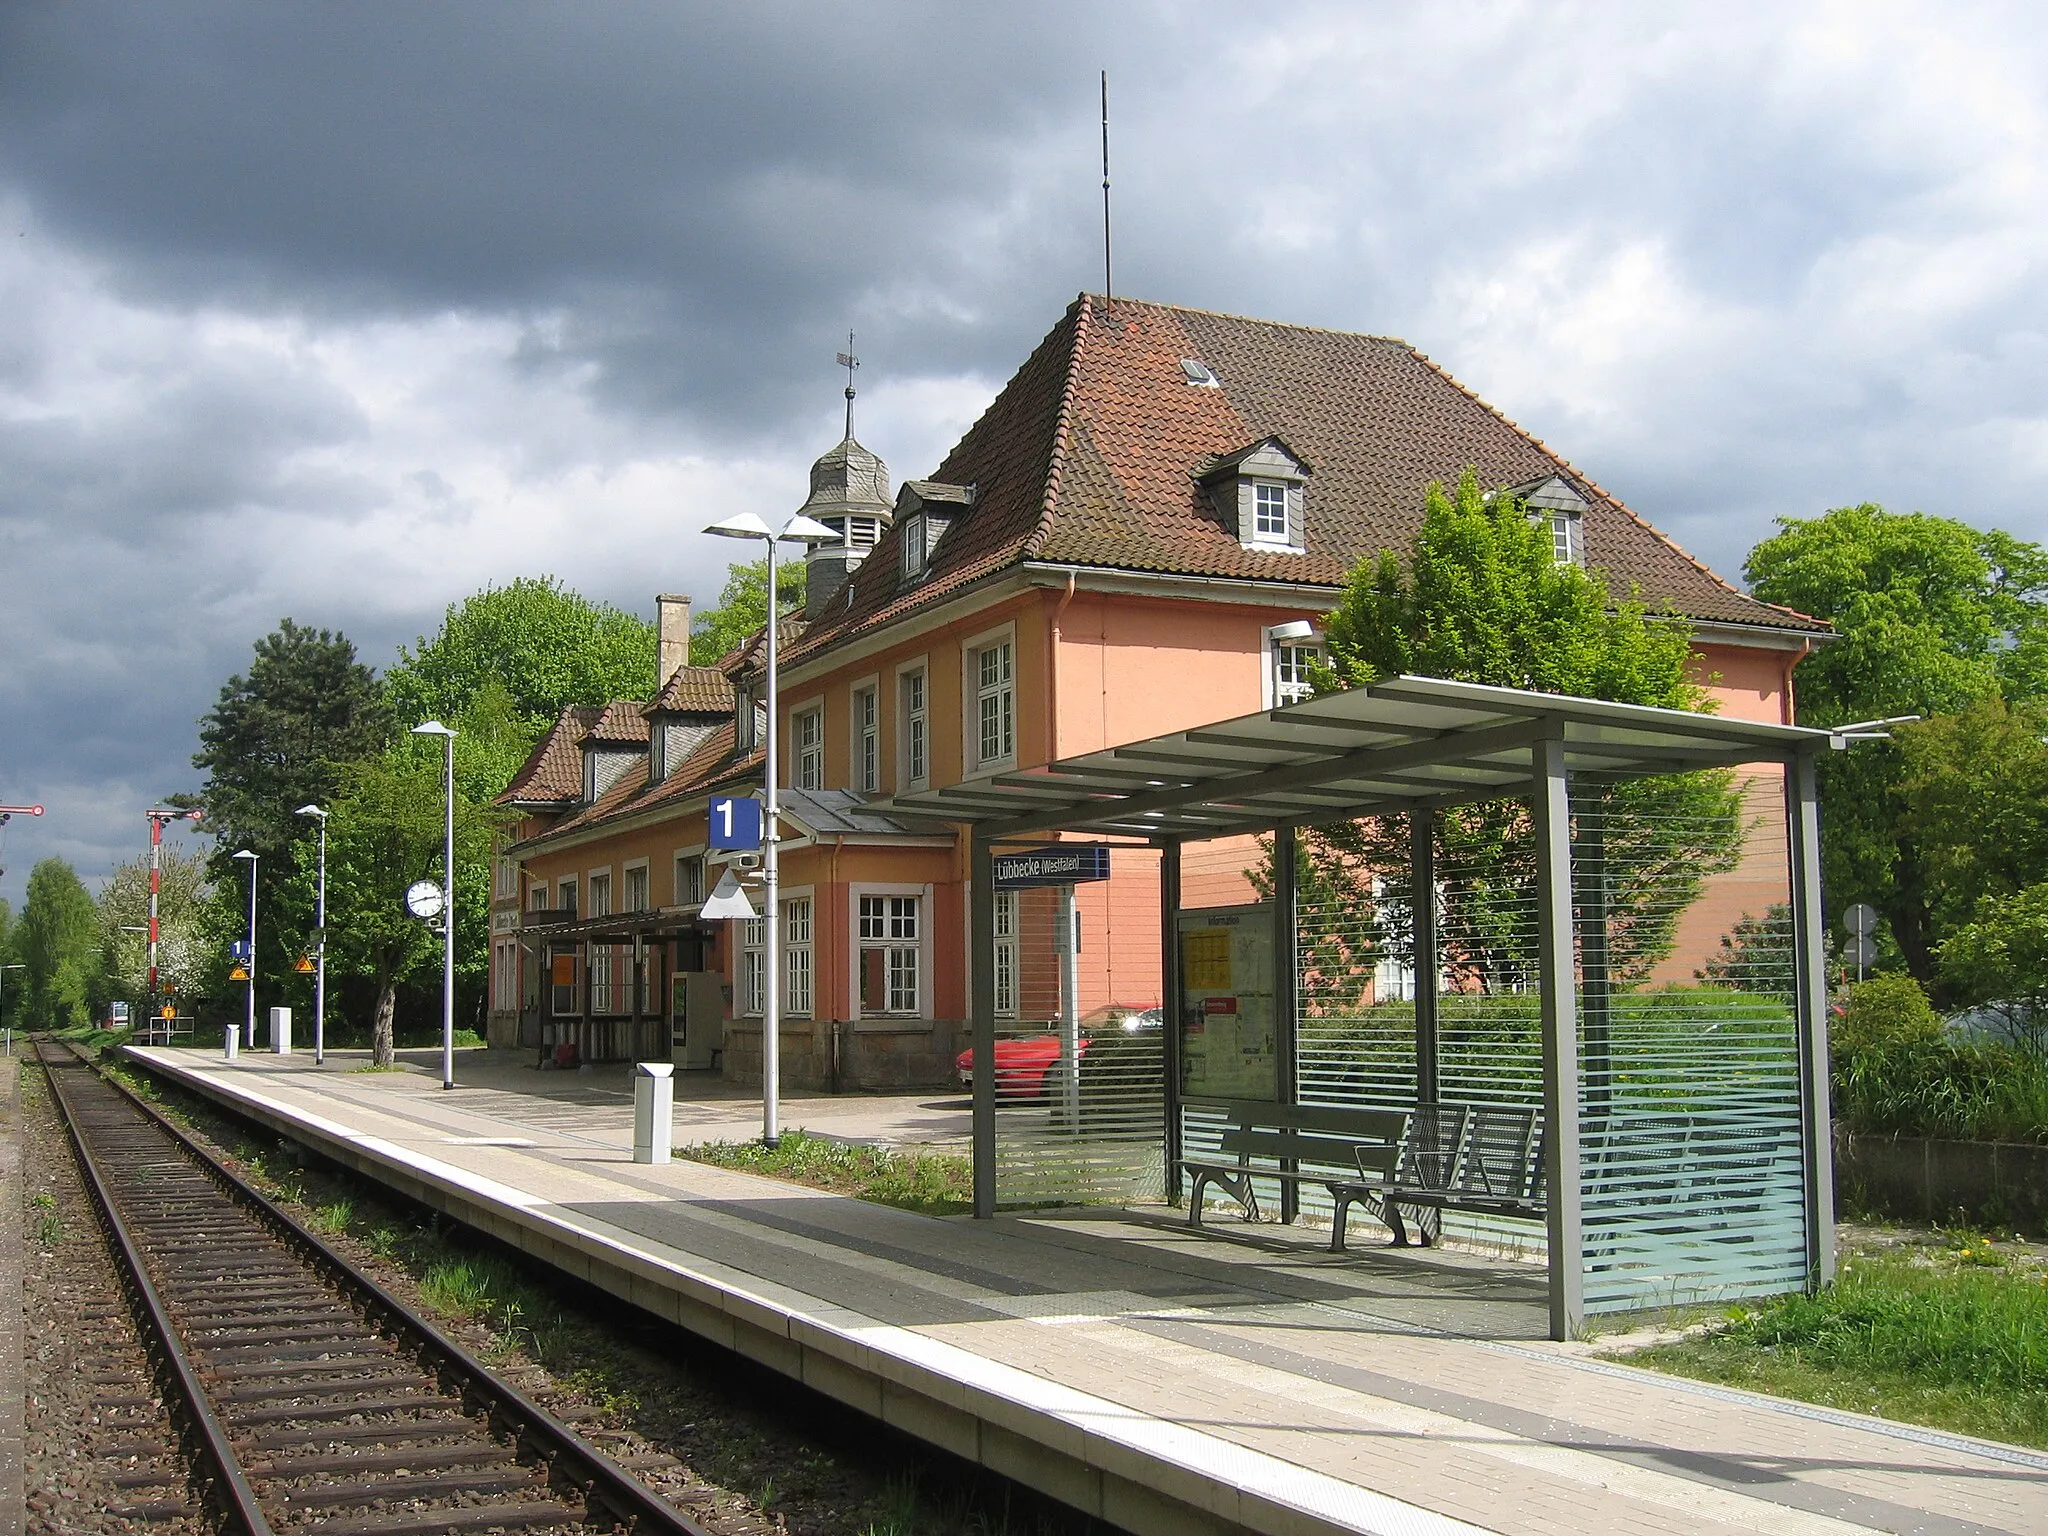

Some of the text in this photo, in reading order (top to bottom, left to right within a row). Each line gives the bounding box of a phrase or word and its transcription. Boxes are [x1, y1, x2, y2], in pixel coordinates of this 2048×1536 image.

[716, 799, 733, 838] 1
[998, 854, 1080, 881] Lübbecke (Westfalen)
[1207, 914, 1240, 926] Information
[233, 940, 241, 955] 1
